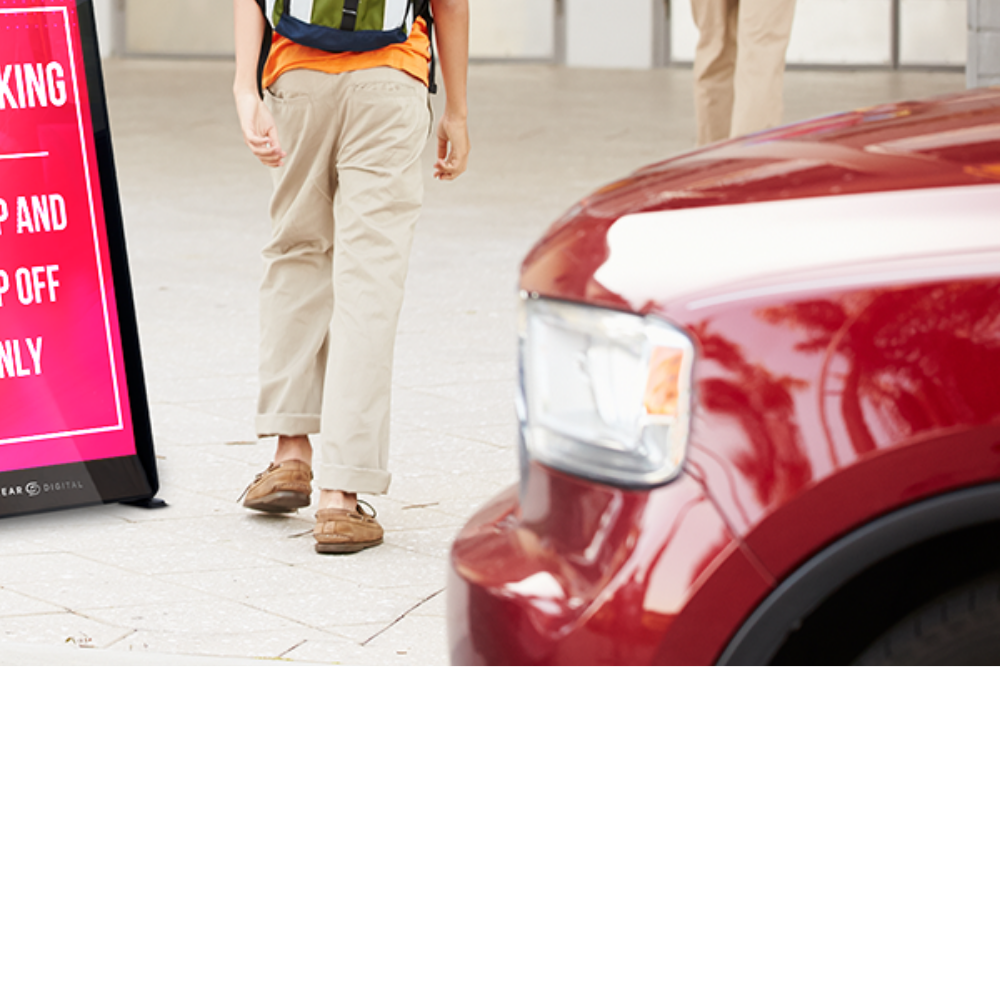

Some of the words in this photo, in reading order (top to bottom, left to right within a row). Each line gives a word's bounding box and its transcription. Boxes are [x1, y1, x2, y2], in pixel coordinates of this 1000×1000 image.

[16, 193, 67, 234] AND
[15, 264, 60, 305] OFF
[43, 480, 83, 492] DIGITAL
